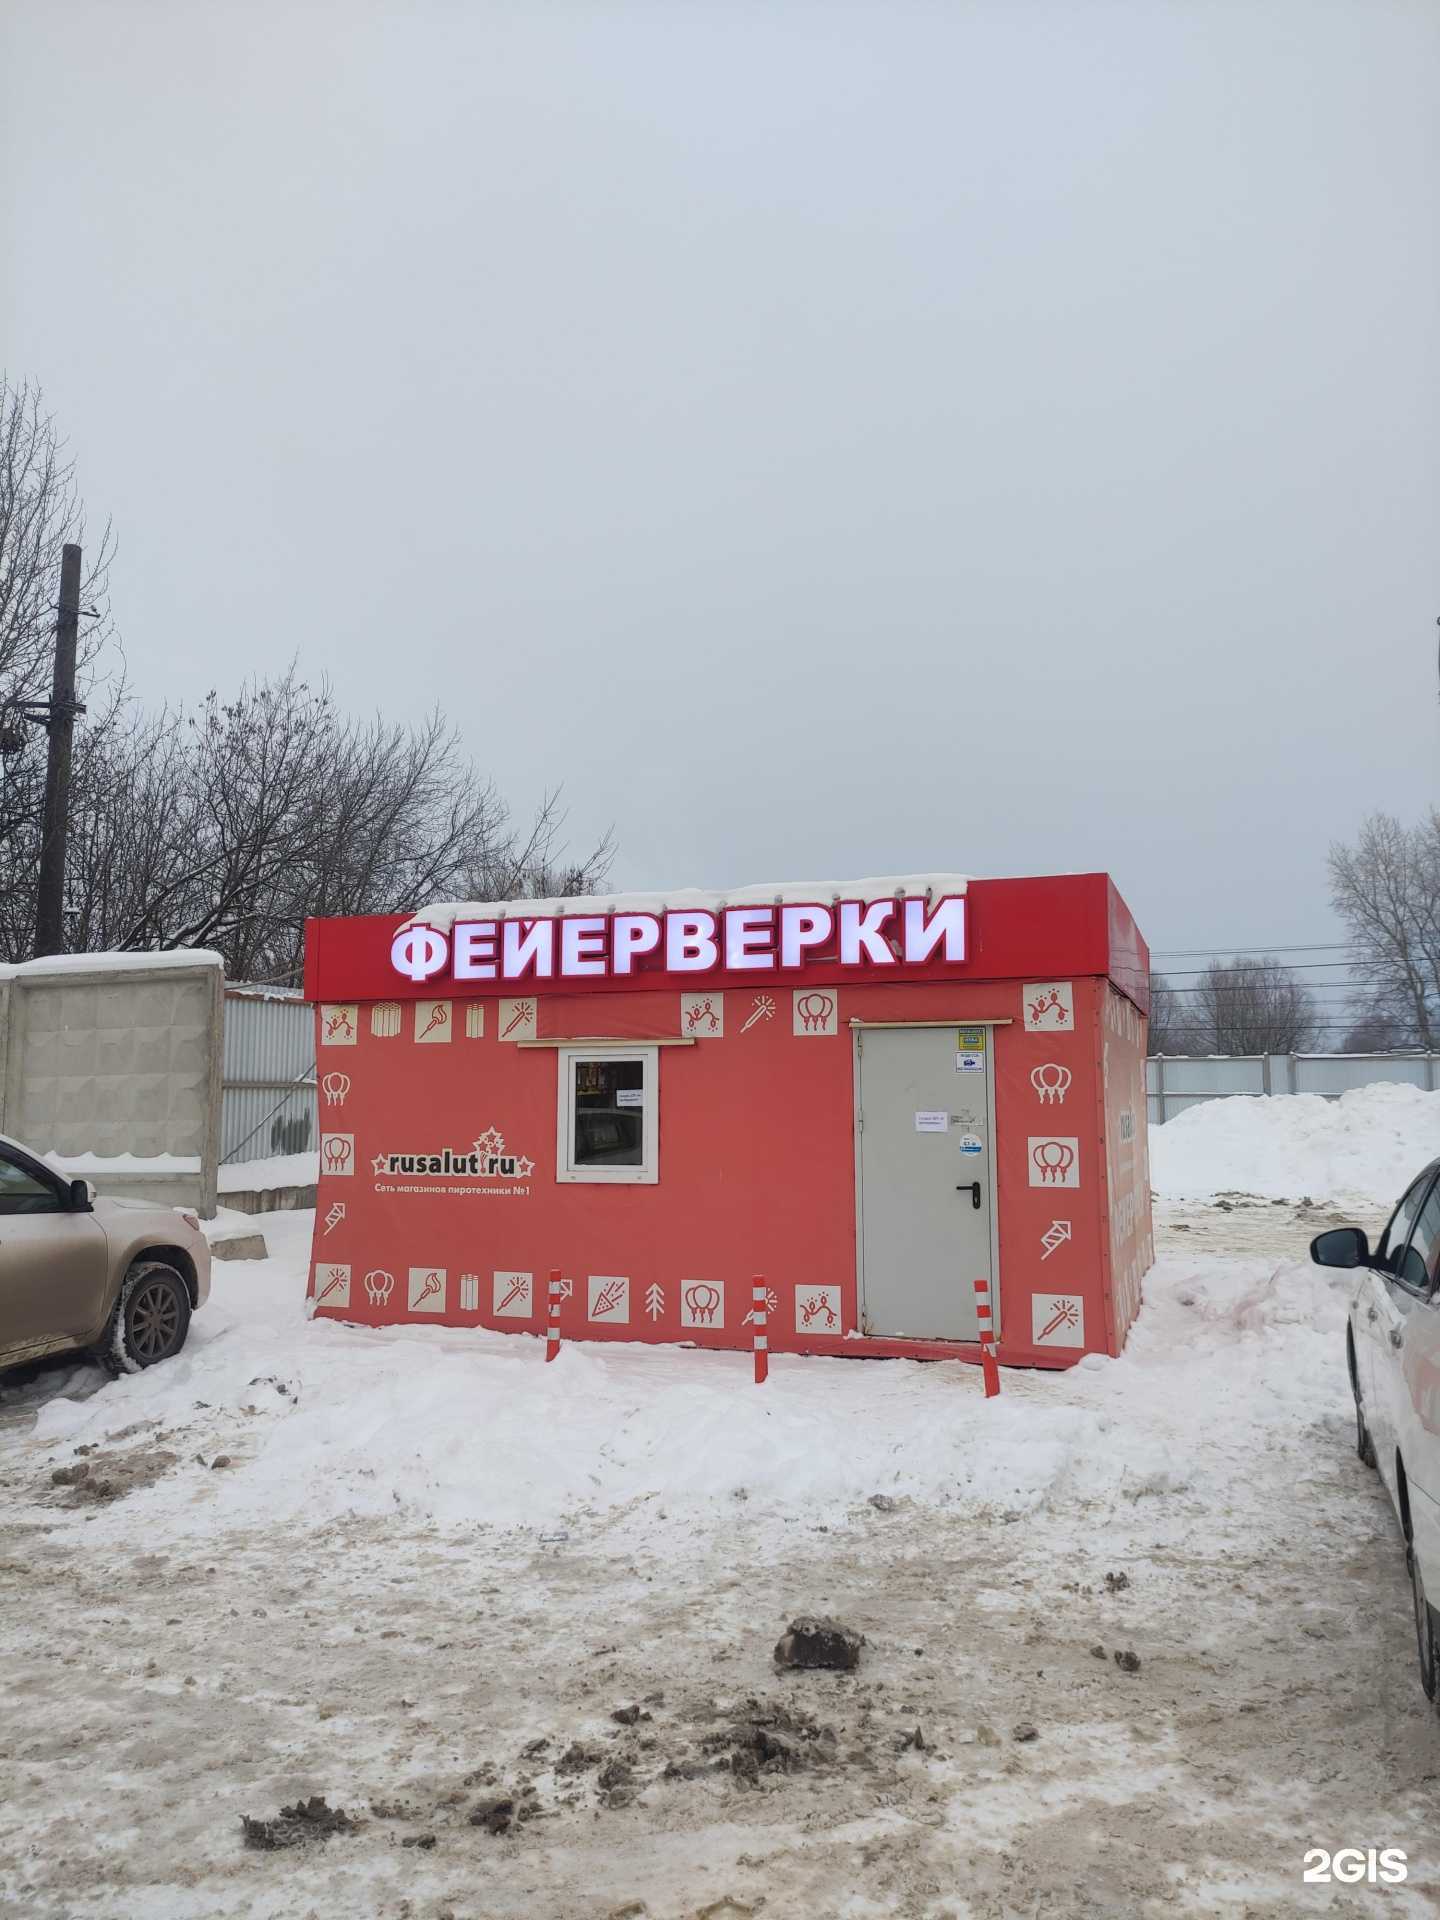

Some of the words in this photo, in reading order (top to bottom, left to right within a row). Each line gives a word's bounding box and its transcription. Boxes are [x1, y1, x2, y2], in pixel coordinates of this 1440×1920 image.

[391, 896, 967, 982] ФЕЙЕРВЕРКИ
[374, 1183, 395, 1193] Сеть
[397, 1185, 446, 1194] магазинов
[448, 1187, 510, 1196] пиротехники
